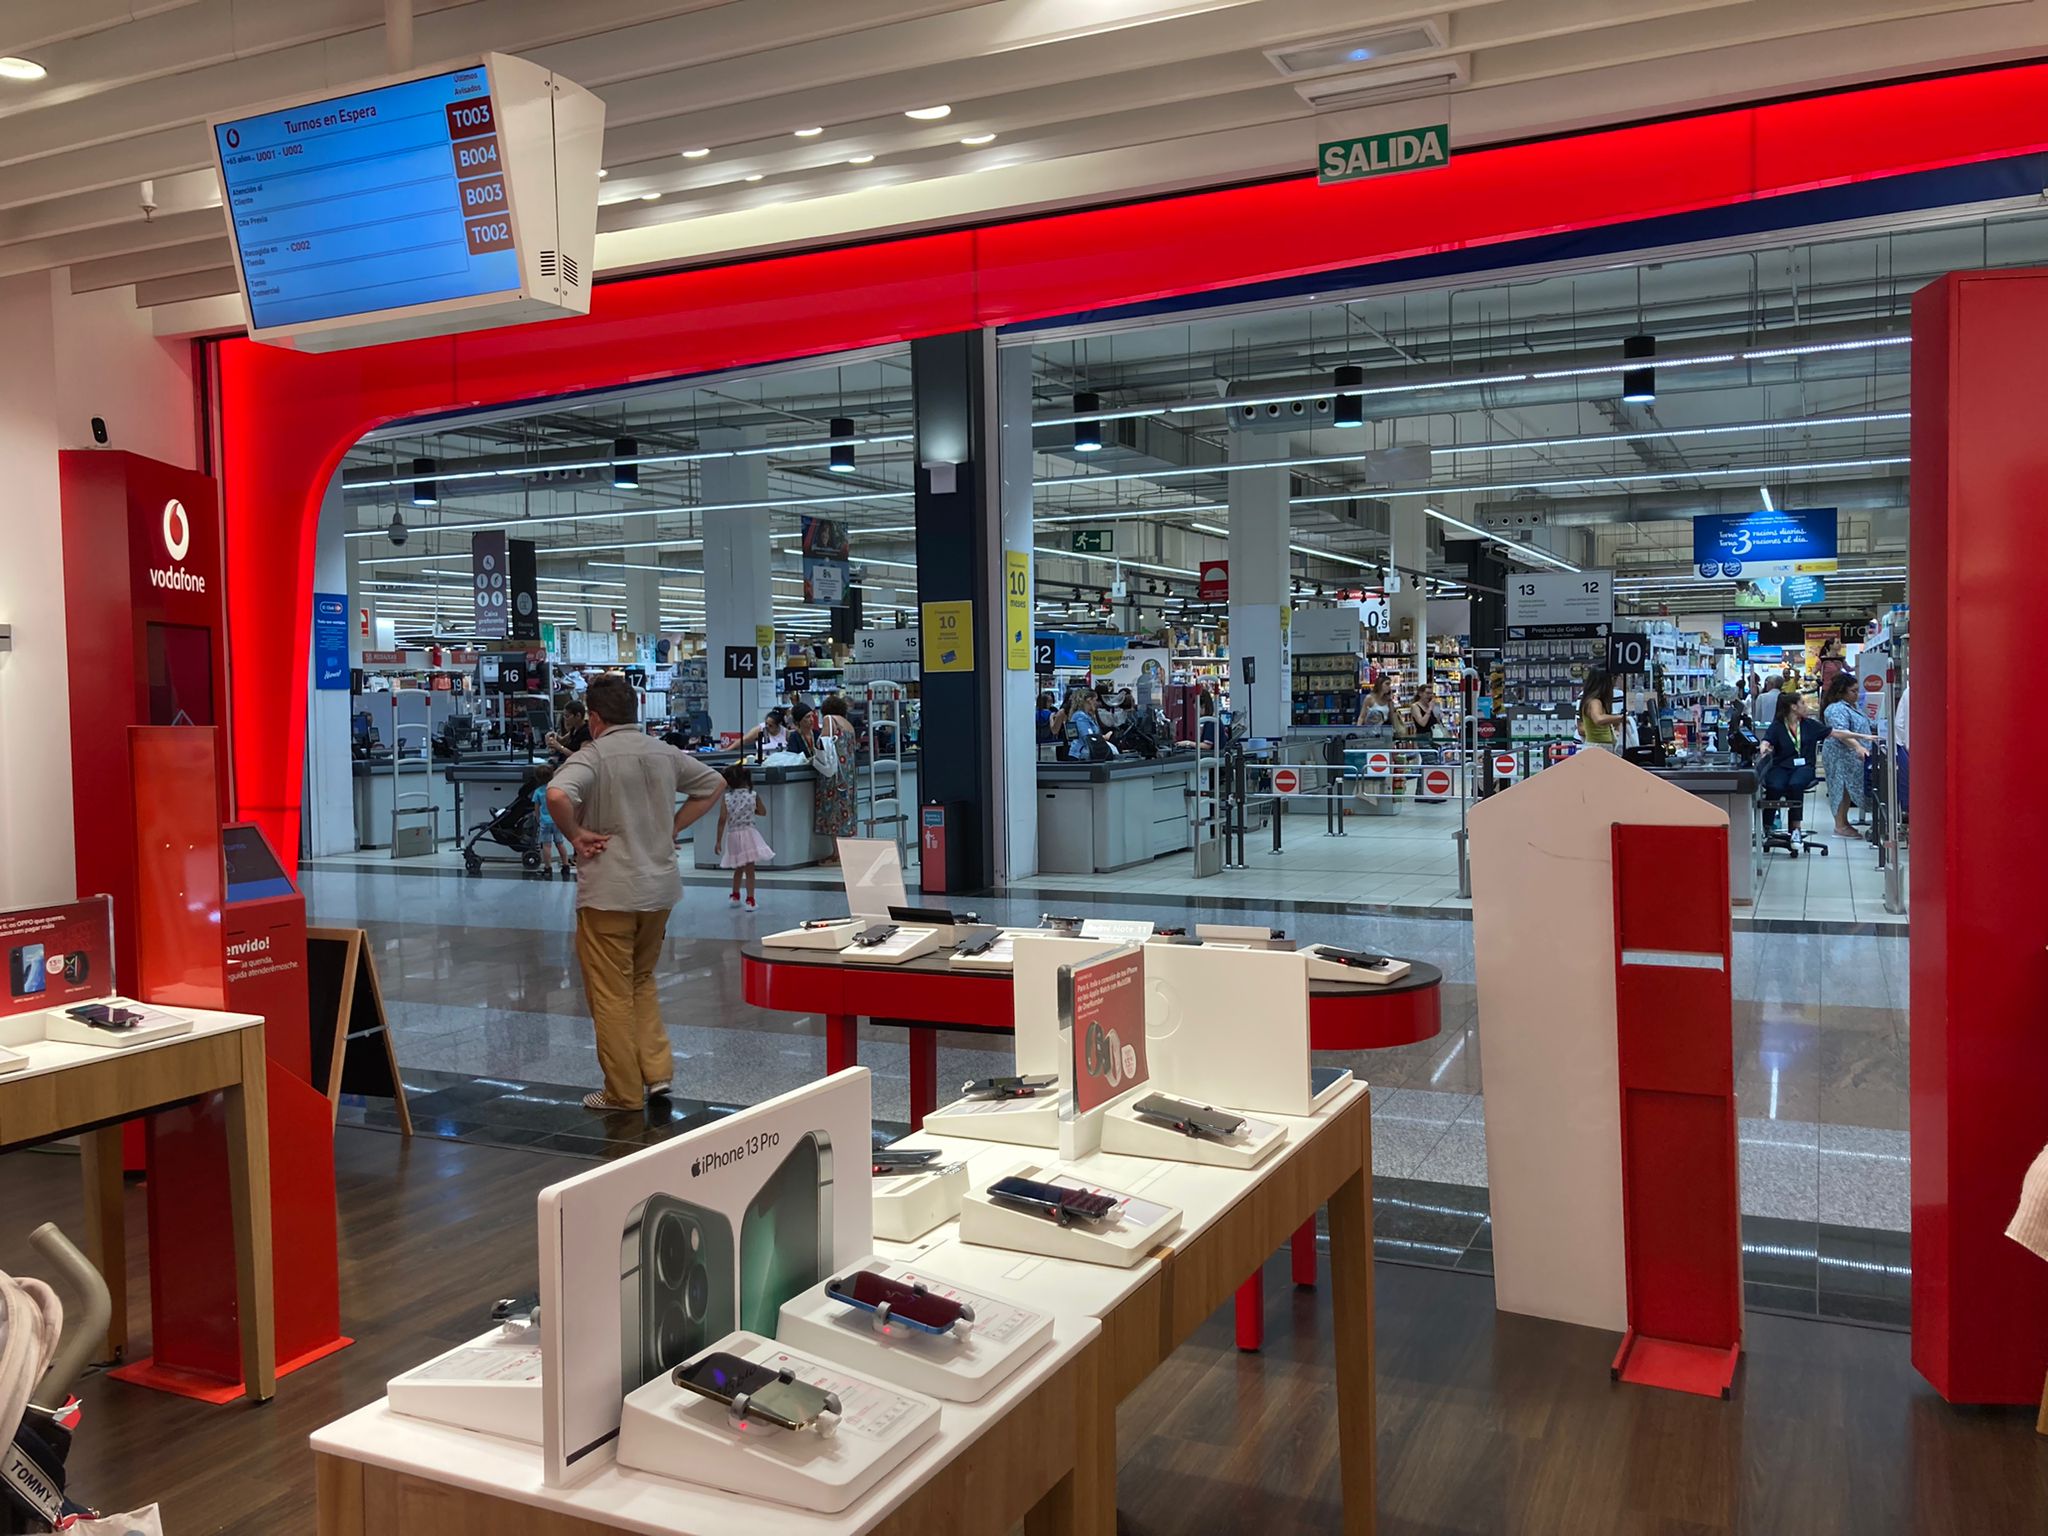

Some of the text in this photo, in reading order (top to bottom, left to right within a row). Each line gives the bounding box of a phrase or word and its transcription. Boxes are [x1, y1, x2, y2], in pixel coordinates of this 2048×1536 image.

[454, 84, 482, 96] Avisados
[284, 103, 377, 134] Turnos en Espera
[452, 105, 490, 128] T003
[256, 149, 276, 162] U001
[282, 144, 304, 157] U002
[459, 144, 497, 167] B004
[1324, 131, 1444, 177] SALIDA
[465, 184, 503, 206] B003
[471, 222, 509, 244] T002
[290, 240, 311, 252] C002
[1731, 529, 1753, 555] 3
[149, 565, 206, 593] vodafone
[1010, 570, 1026, 596] 10
[1582, 581, 1599, 593] 12
[1518, 584, 1535, 596] 13
[938, 615, 956, 629] 10
[862, 638, 875, 649] 16
[904, 637, 917, 647] 15
[729, 652, 754, 672] 14
[1034, 645, 1052, 664] 12
[1614, 641, 1642, 665] 10
[452, 678, 462, 691] 19
[503, 669, 519, 683] 16
[628, 674, 643, 687] 17
[787, 671, 806, 686] 15
[17, 918, 34, 927] OPPO
[701, 1132, 780, 1174] iPhone 13 Pro
[11, 1459, 53, 1503] TOMMY
